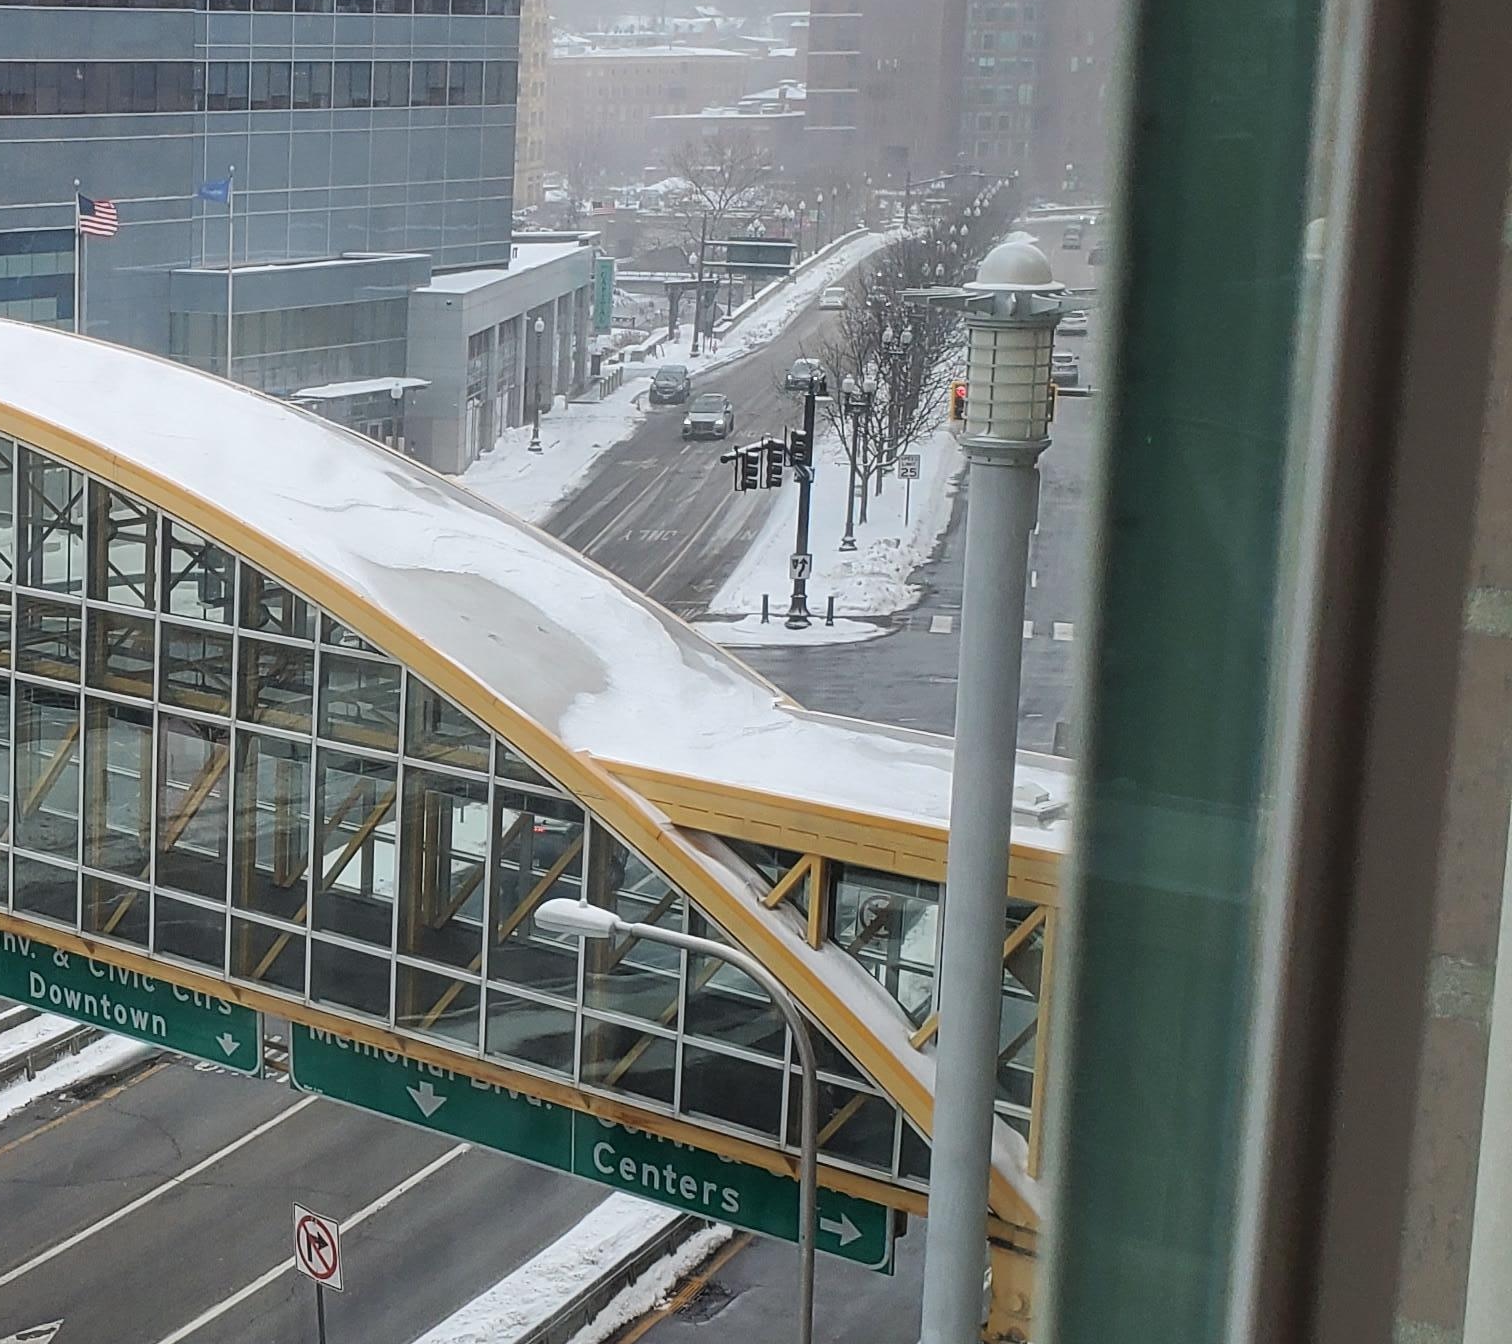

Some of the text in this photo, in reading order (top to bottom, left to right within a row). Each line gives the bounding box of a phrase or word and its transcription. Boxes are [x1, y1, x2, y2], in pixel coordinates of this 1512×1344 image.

[900, 467, 917, 477] 25
[29, 970, 168, 1038] Downtown
[593, 1141, 740, 1213] Centers
